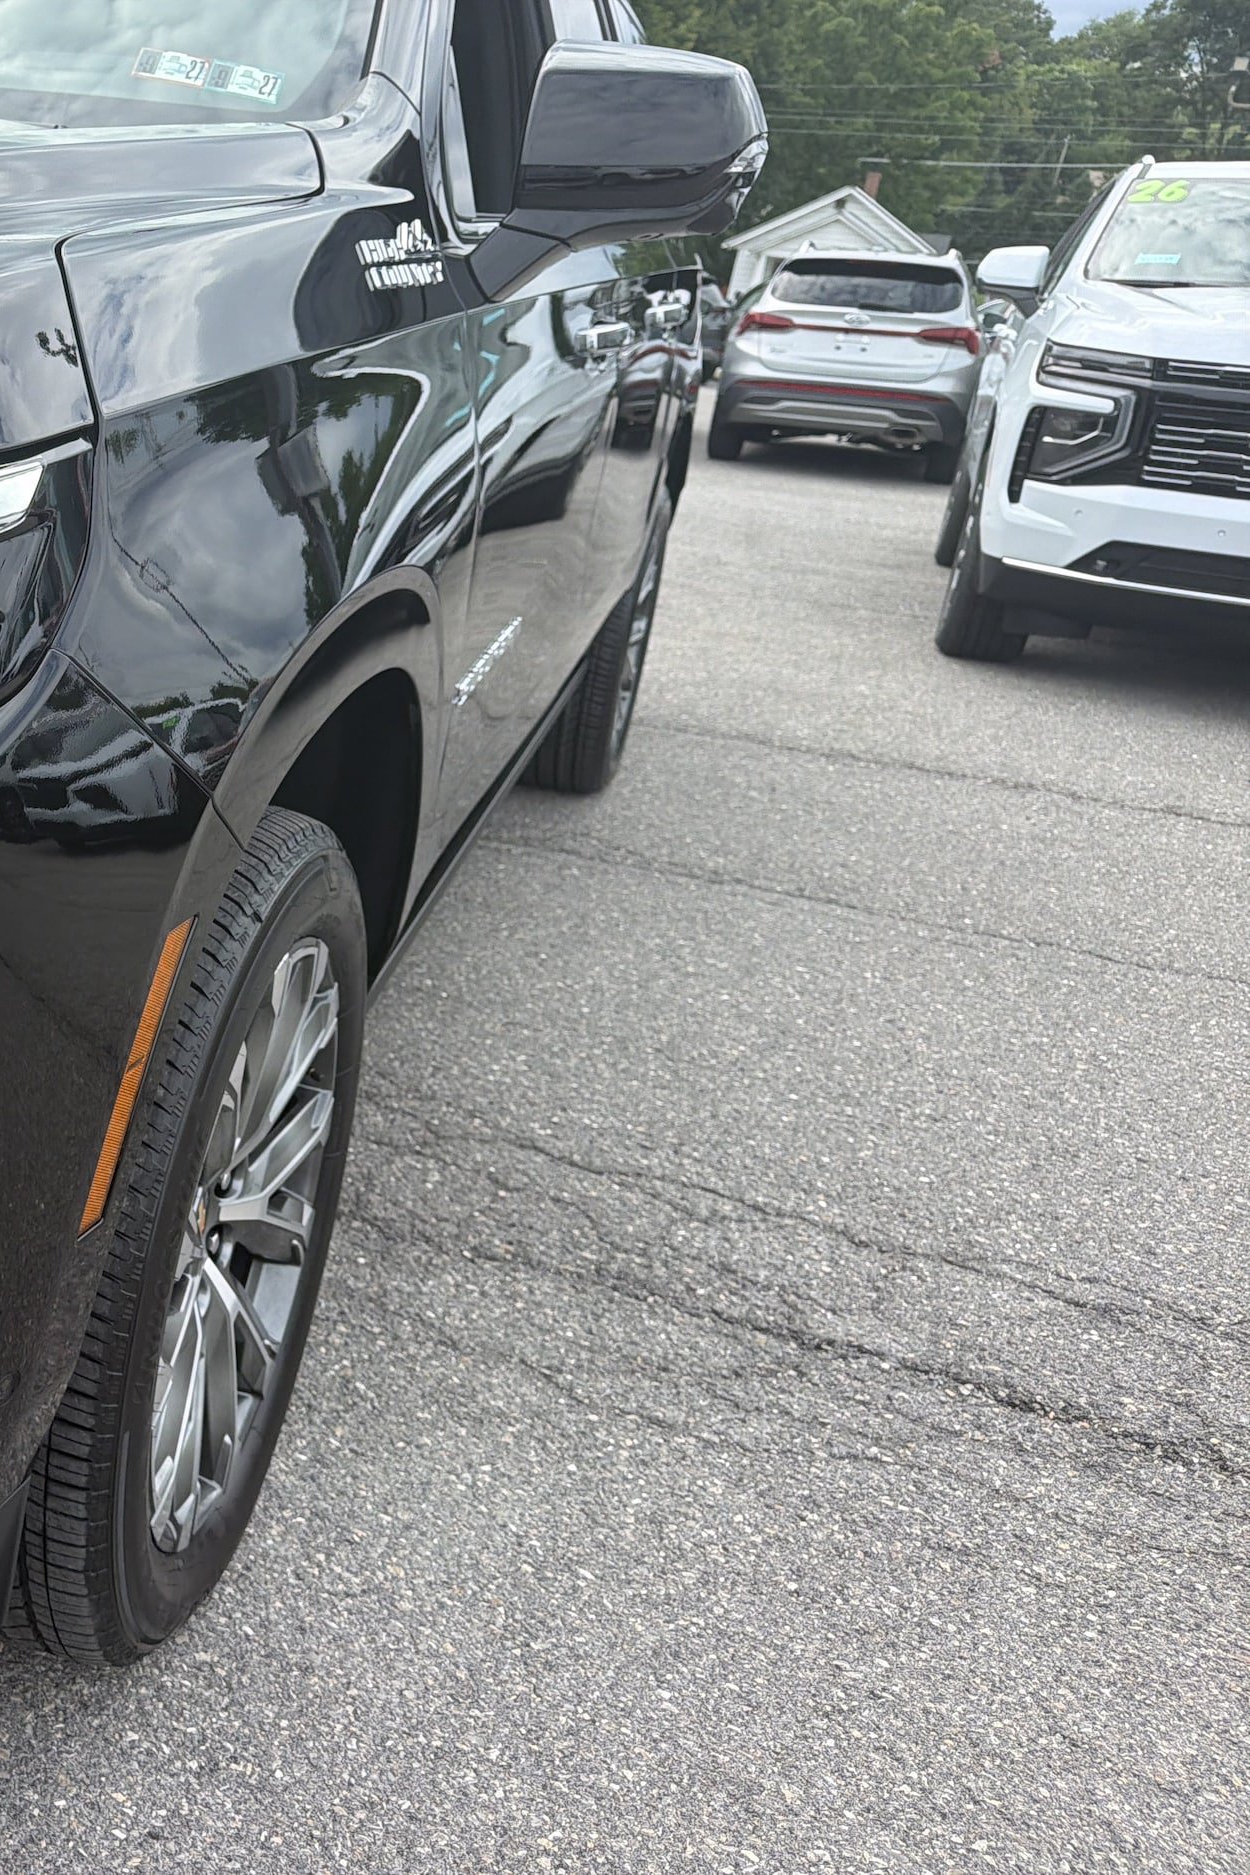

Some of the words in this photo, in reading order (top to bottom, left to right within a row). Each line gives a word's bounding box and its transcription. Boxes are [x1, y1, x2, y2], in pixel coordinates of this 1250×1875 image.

[185, 60, 206, 81] 27
[258, 75, 278, 97] 27
[1127, 179, 1190, 203] 26
